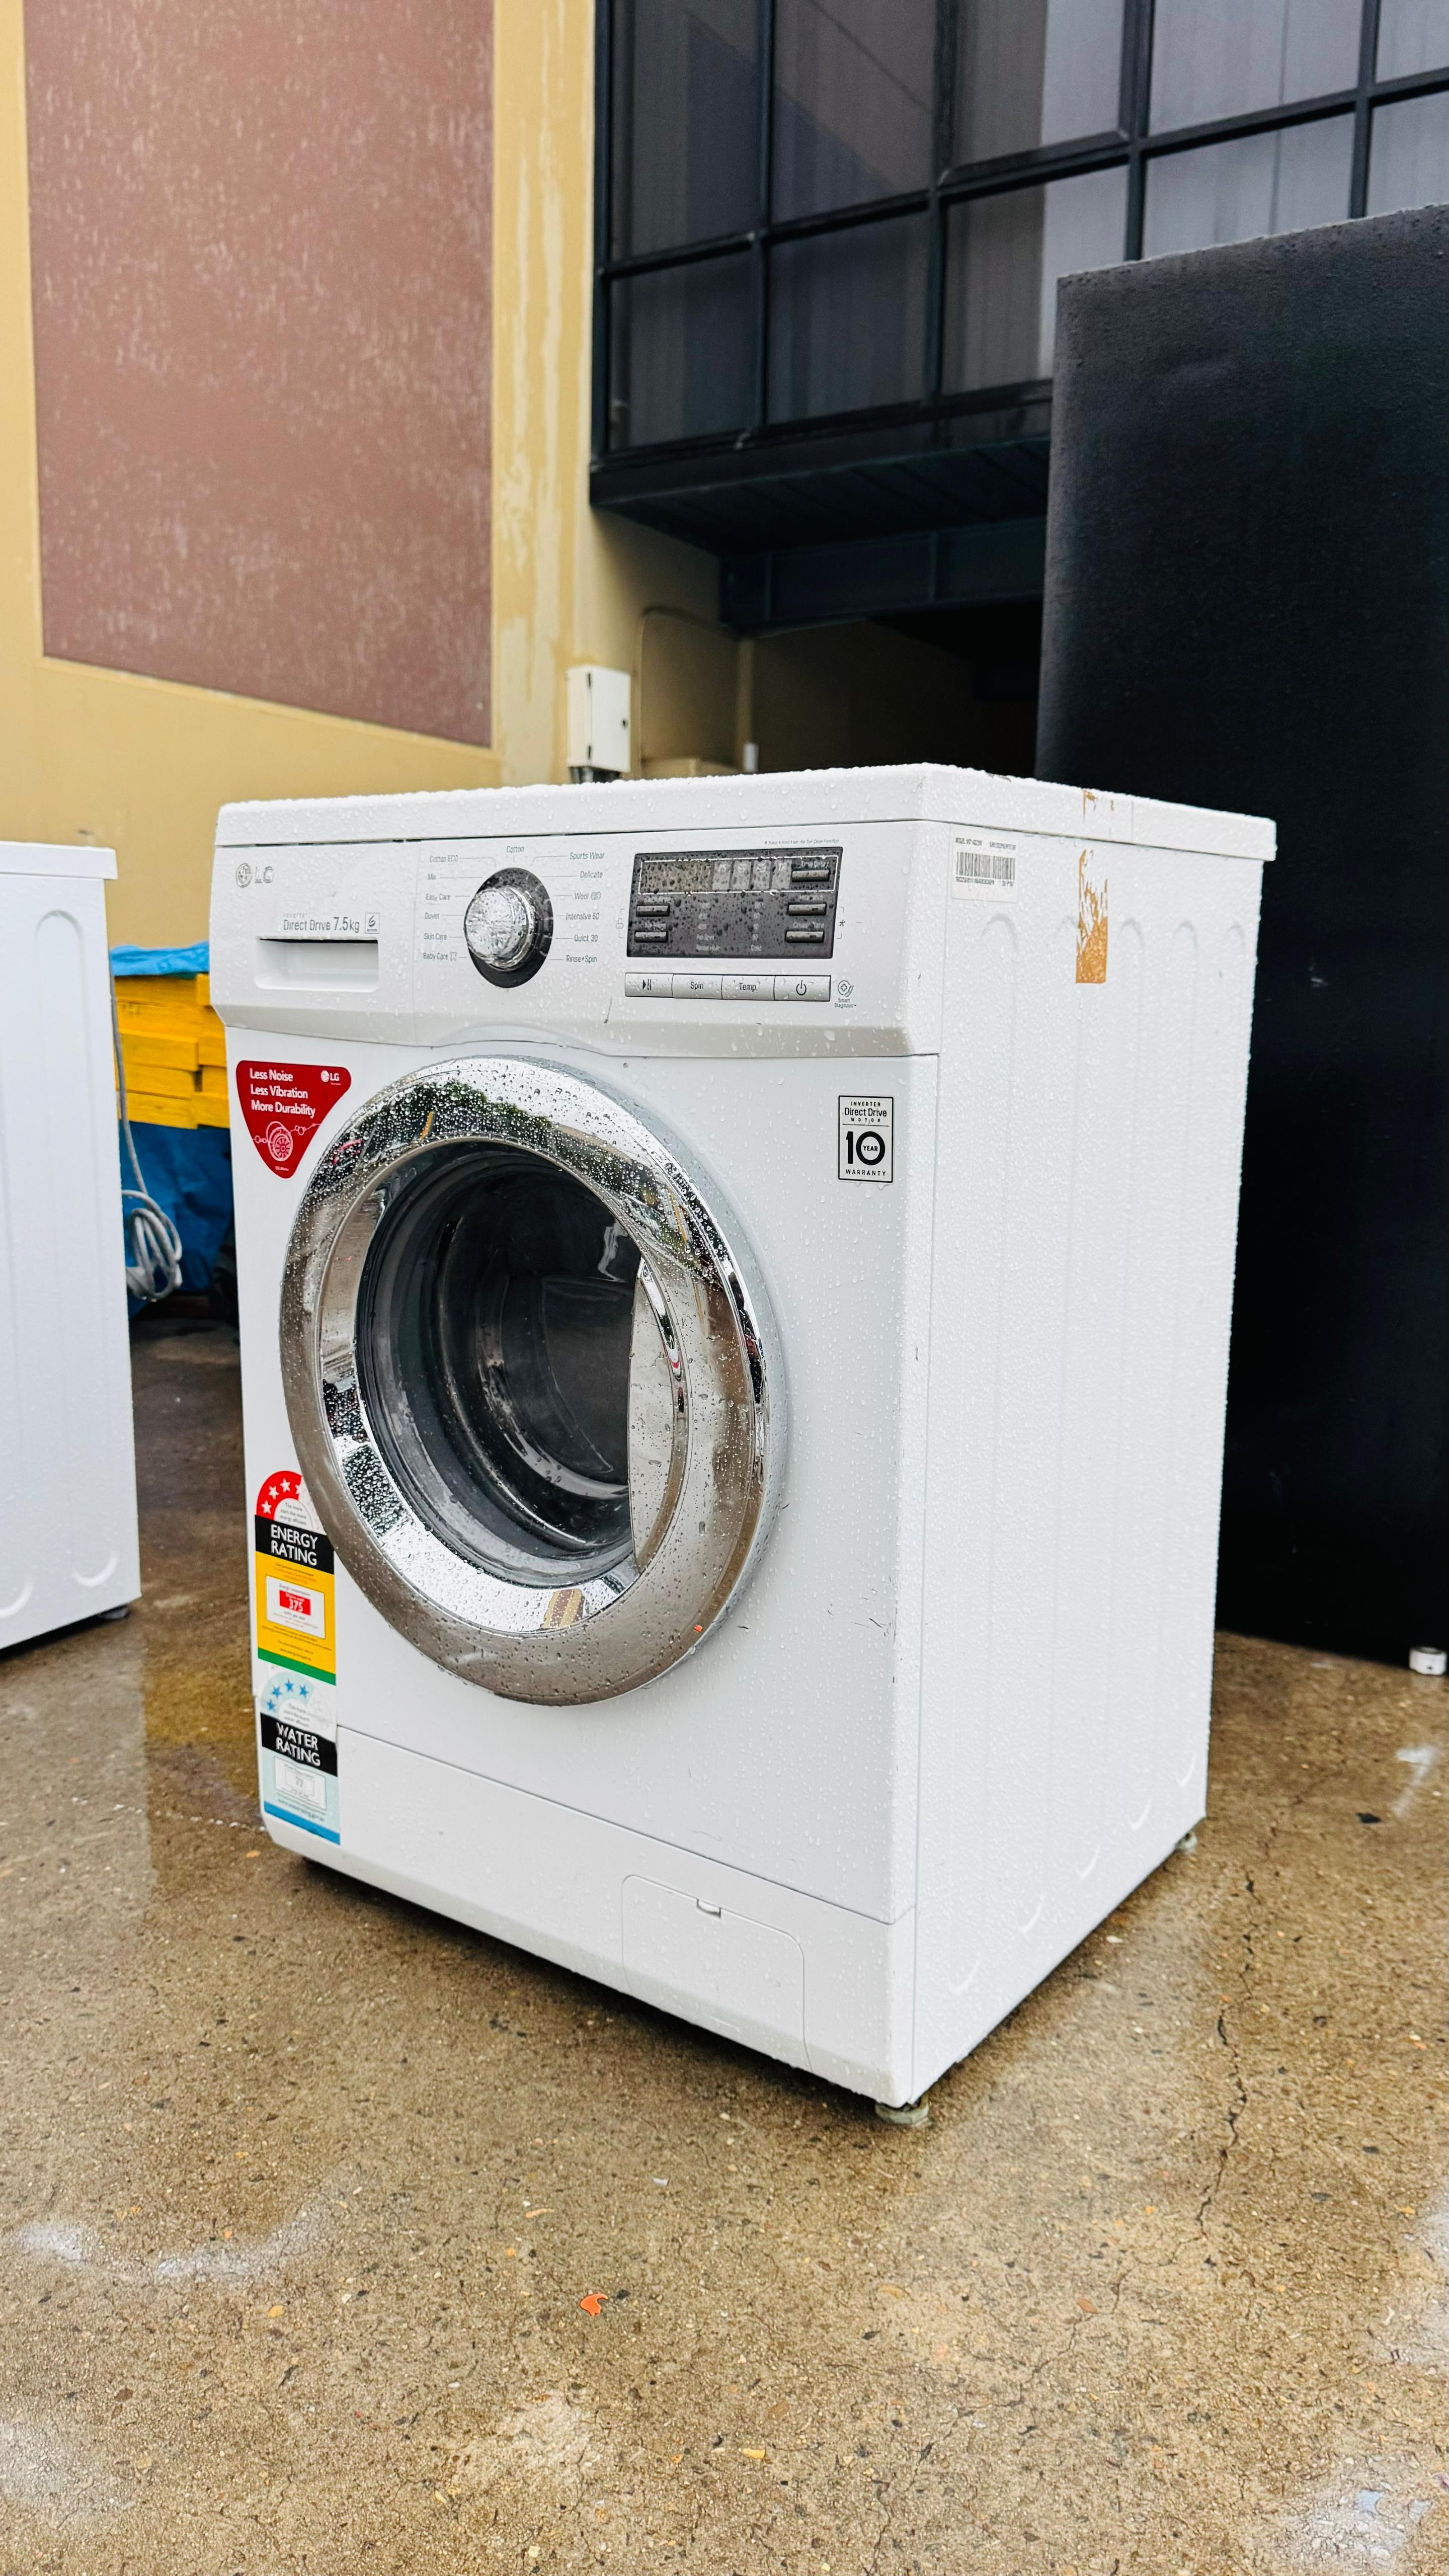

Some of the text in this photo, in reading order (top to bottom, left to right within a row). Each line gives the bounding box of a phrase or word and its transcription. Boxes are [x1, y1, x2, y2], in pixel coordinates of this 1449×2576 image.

[570, 852, 588, 861] Sports
[255, 866, 274, 883] LG
[565, 912, 600, 921] Intensive 60
[283, 917, 360, 933] Direct Drive 7.5kg
[423, 952, 449, 961] Baby Care
[690, 981, 704, 991] Spin
[250, 1068, 294, 1082] Less Noise
[330, 1072, 340, 1082] LG
[251, 1083, 308, 1099] Less Vibration
[251, 1099, 316, 1119] More Durability
[845, 1107, 887, 1117] Direct Drive
[846, 1131, 886, 1166] 10
[270, 1523, 318, 1550] ENERGY
[271, 1540, 317, 1566] RATING
[288, 1598, 303, 1613] 375
[276, 1722, 318, 1751] WATER
[276, 1736, 321, 1766] RATING
